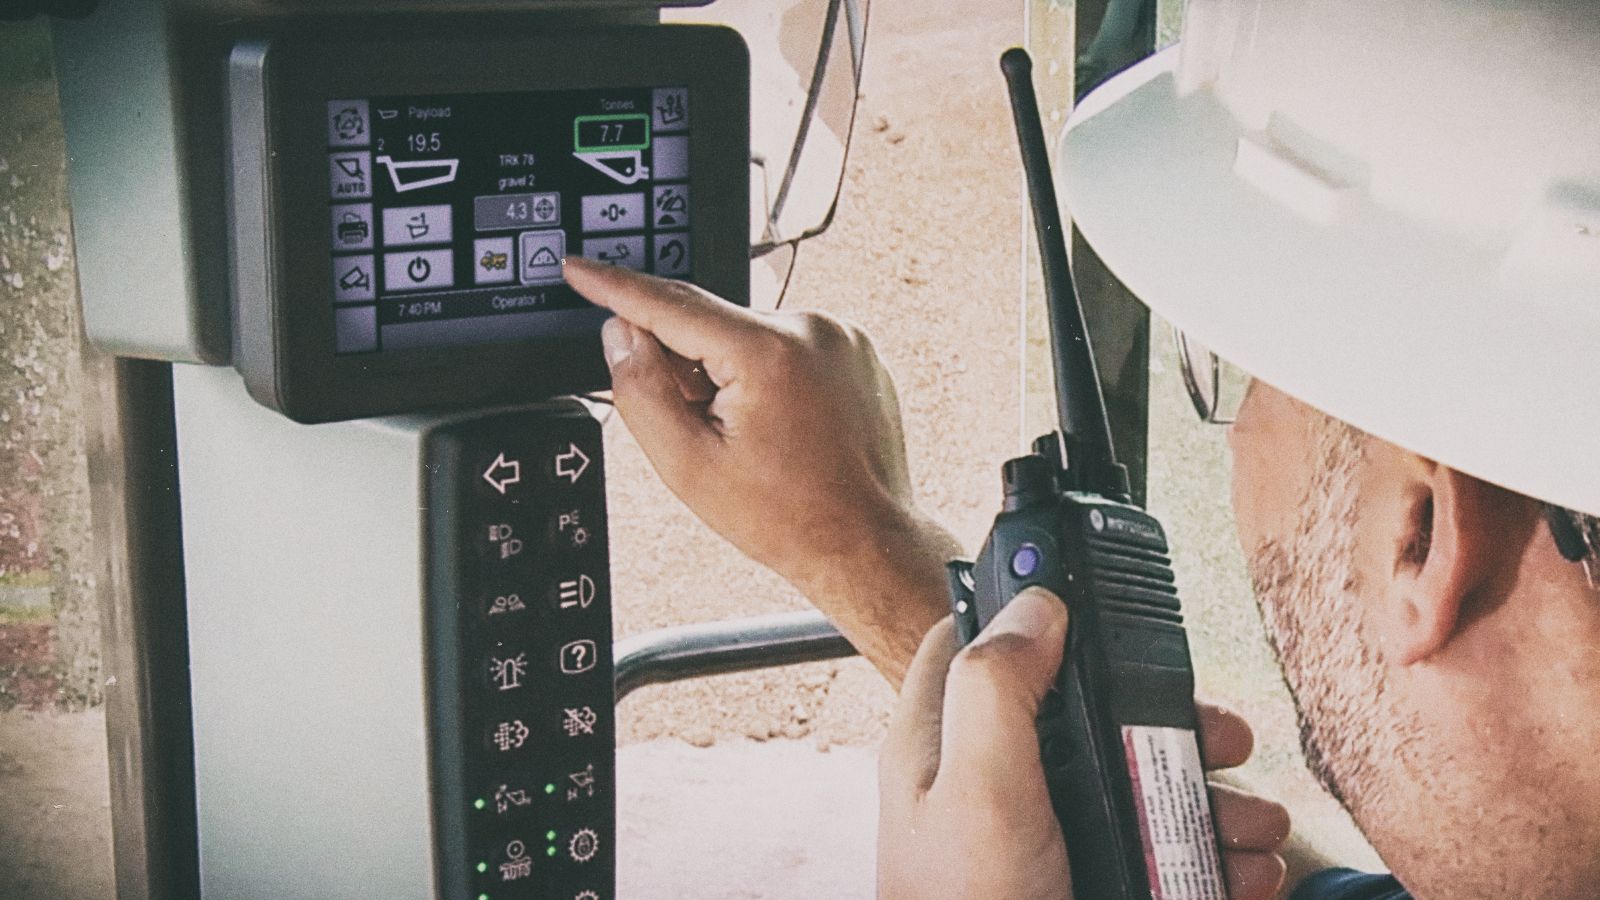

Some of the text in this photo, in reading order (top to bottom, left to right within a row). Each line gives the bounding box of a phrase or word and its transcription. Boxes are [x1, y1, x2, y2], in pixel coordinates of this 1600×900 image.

[408, 106, 451, 121] Payload
[600, 124, 624, 143] 7.7
[377, 138, 385, 151] 2
[407, 132, 441, 152] 19.5
[337, 182, 366, 194] AUTO
[528, 174, 535, 187] 2
[506, 202, 528, 220] 4.3
[399, 302, 442, 317] 740 PM
[491, 295, 536, 310] Operator
